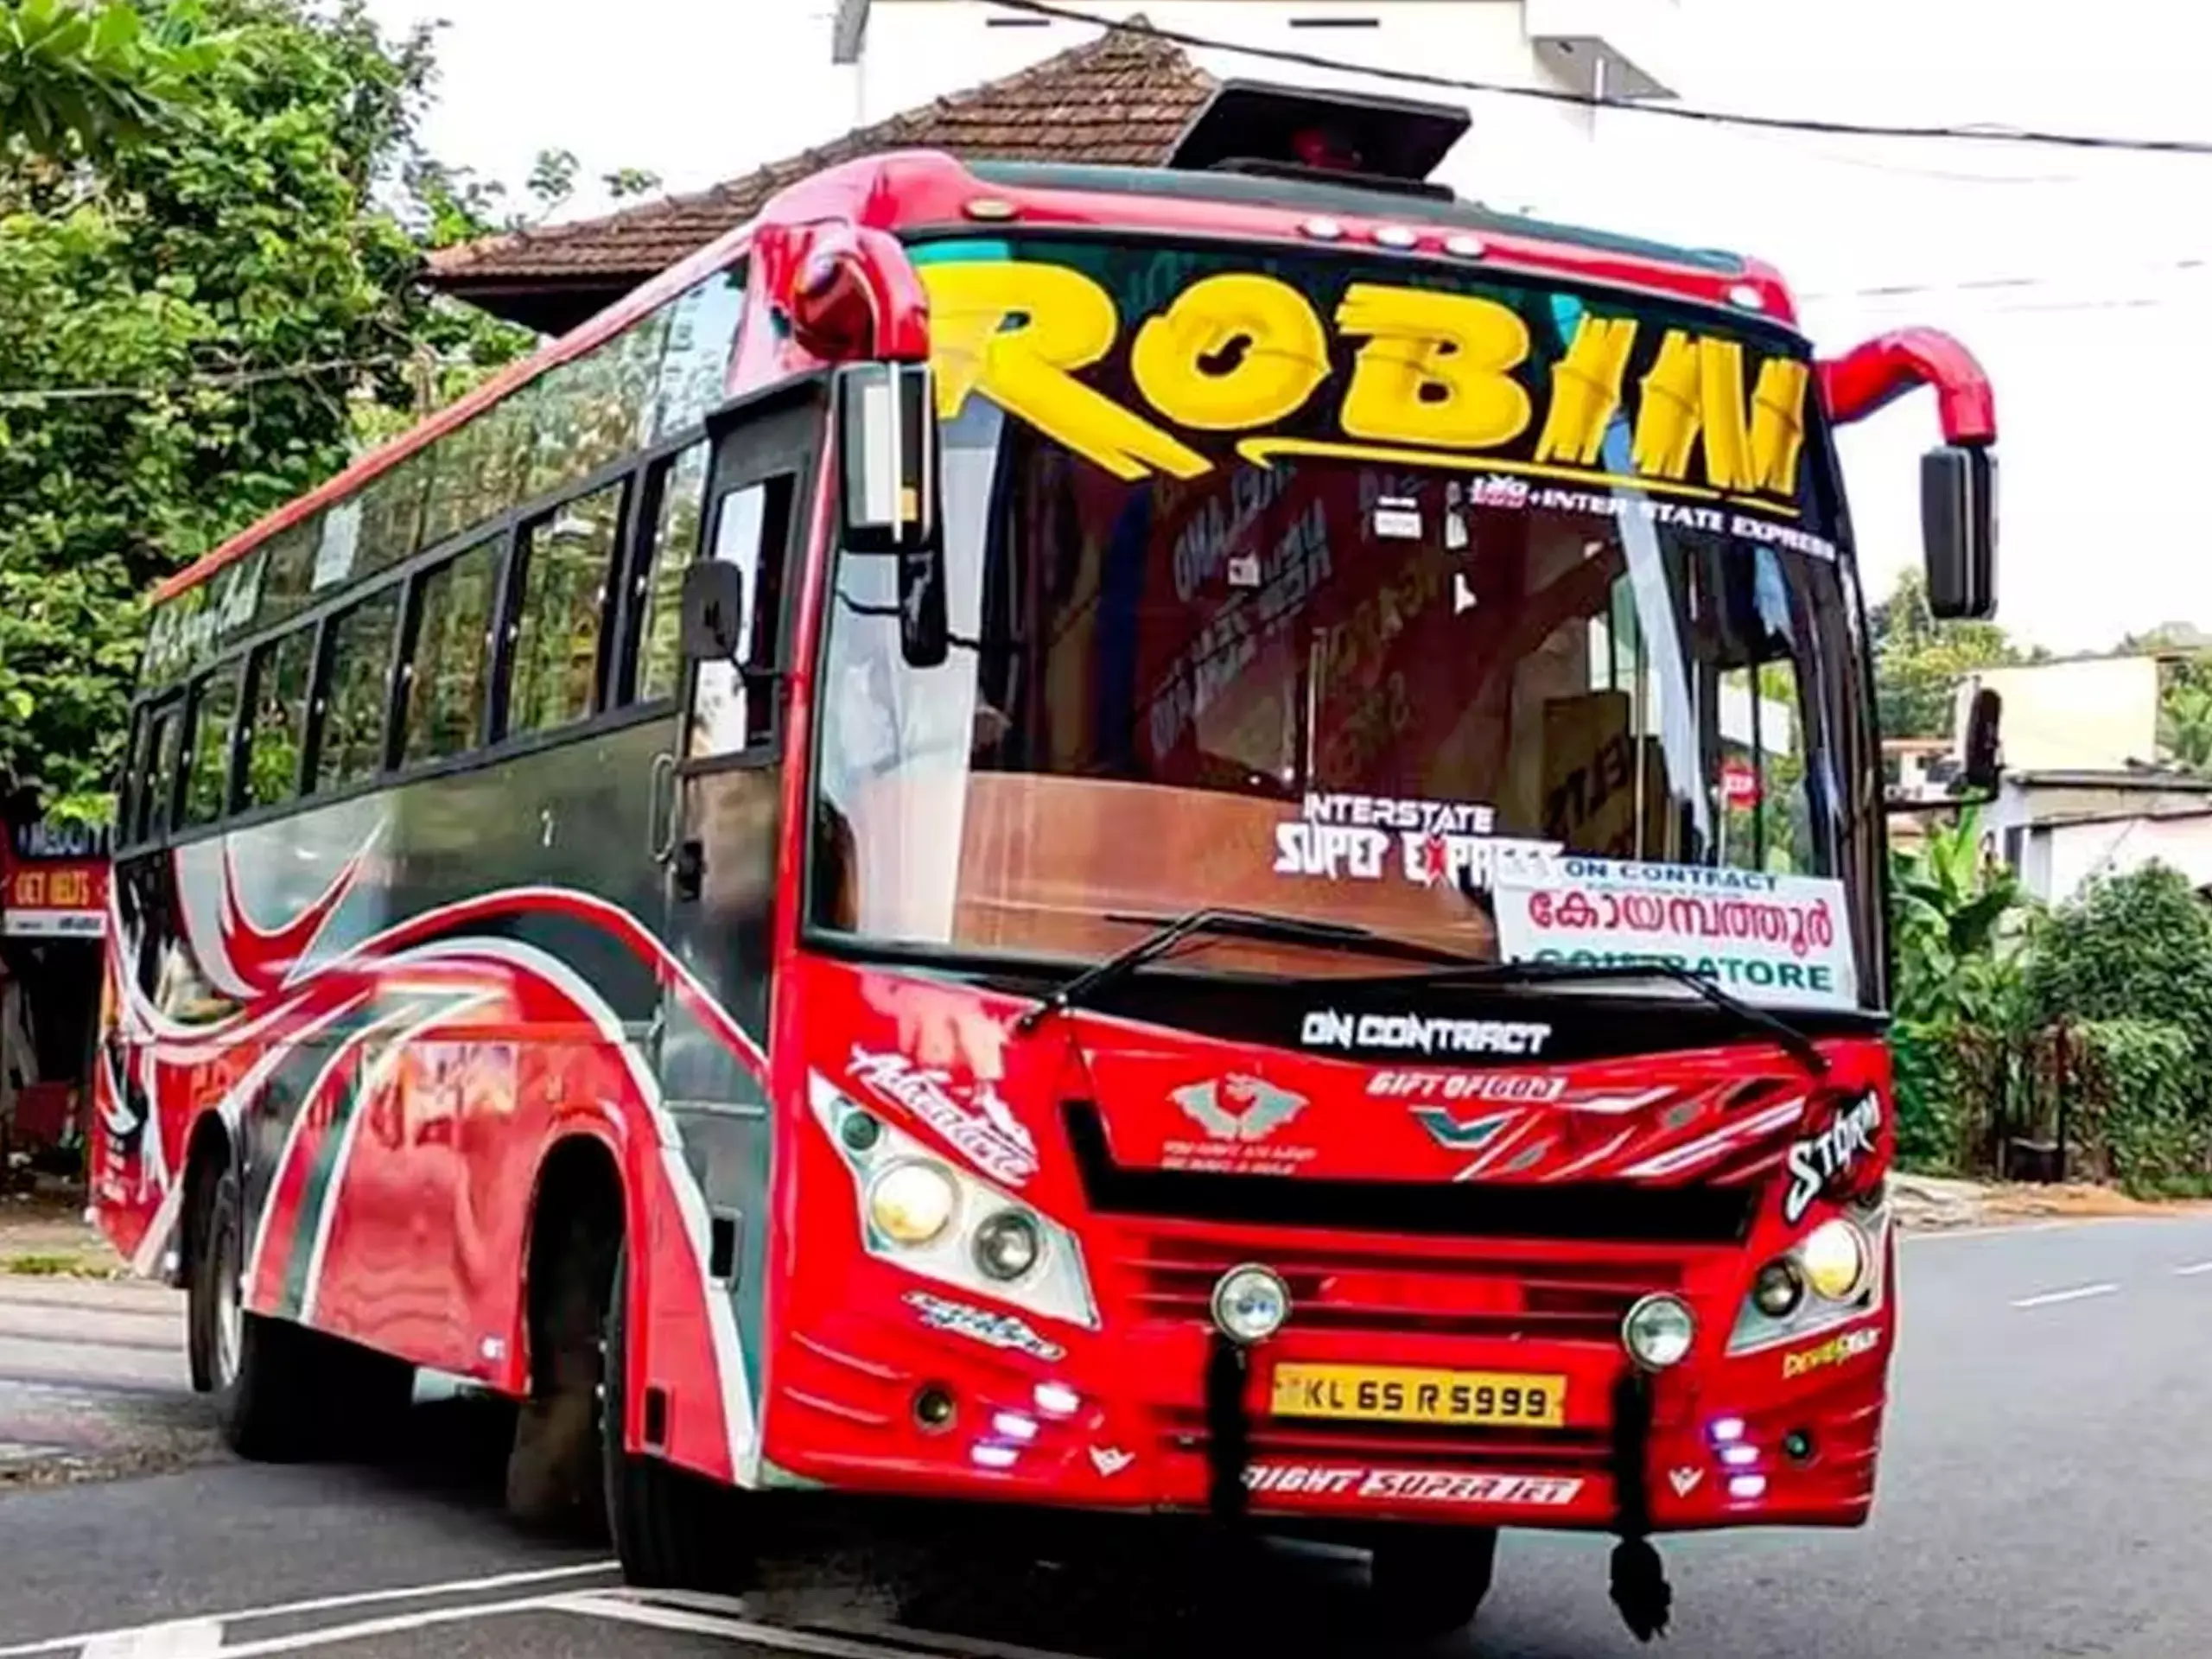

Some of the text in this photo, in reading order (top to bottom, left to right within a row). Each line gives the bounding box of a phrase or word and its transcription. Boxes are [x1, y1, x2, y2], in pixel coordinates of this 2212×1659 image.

[918, 259, 1809, 496] ROBIN
[1542, 487, 1628, 516] INTER
[1303, 791, 1497, 834] INTERSTATE
[1273, 821, 1390, 881] SUPER
[1565, 860, 1608, 879] ON
[1619, 862, 1778, 892] CONTRACT
[1300, 1007, 1552, 1055] ON CONTRACT
[1366, 1071, 1444, 1096] GIFT
[1304, 1379, 1344, 1409] KL
[1418, 1384, 1440, 1413] R
[1451, 1386, 1548, 1417] 5999
